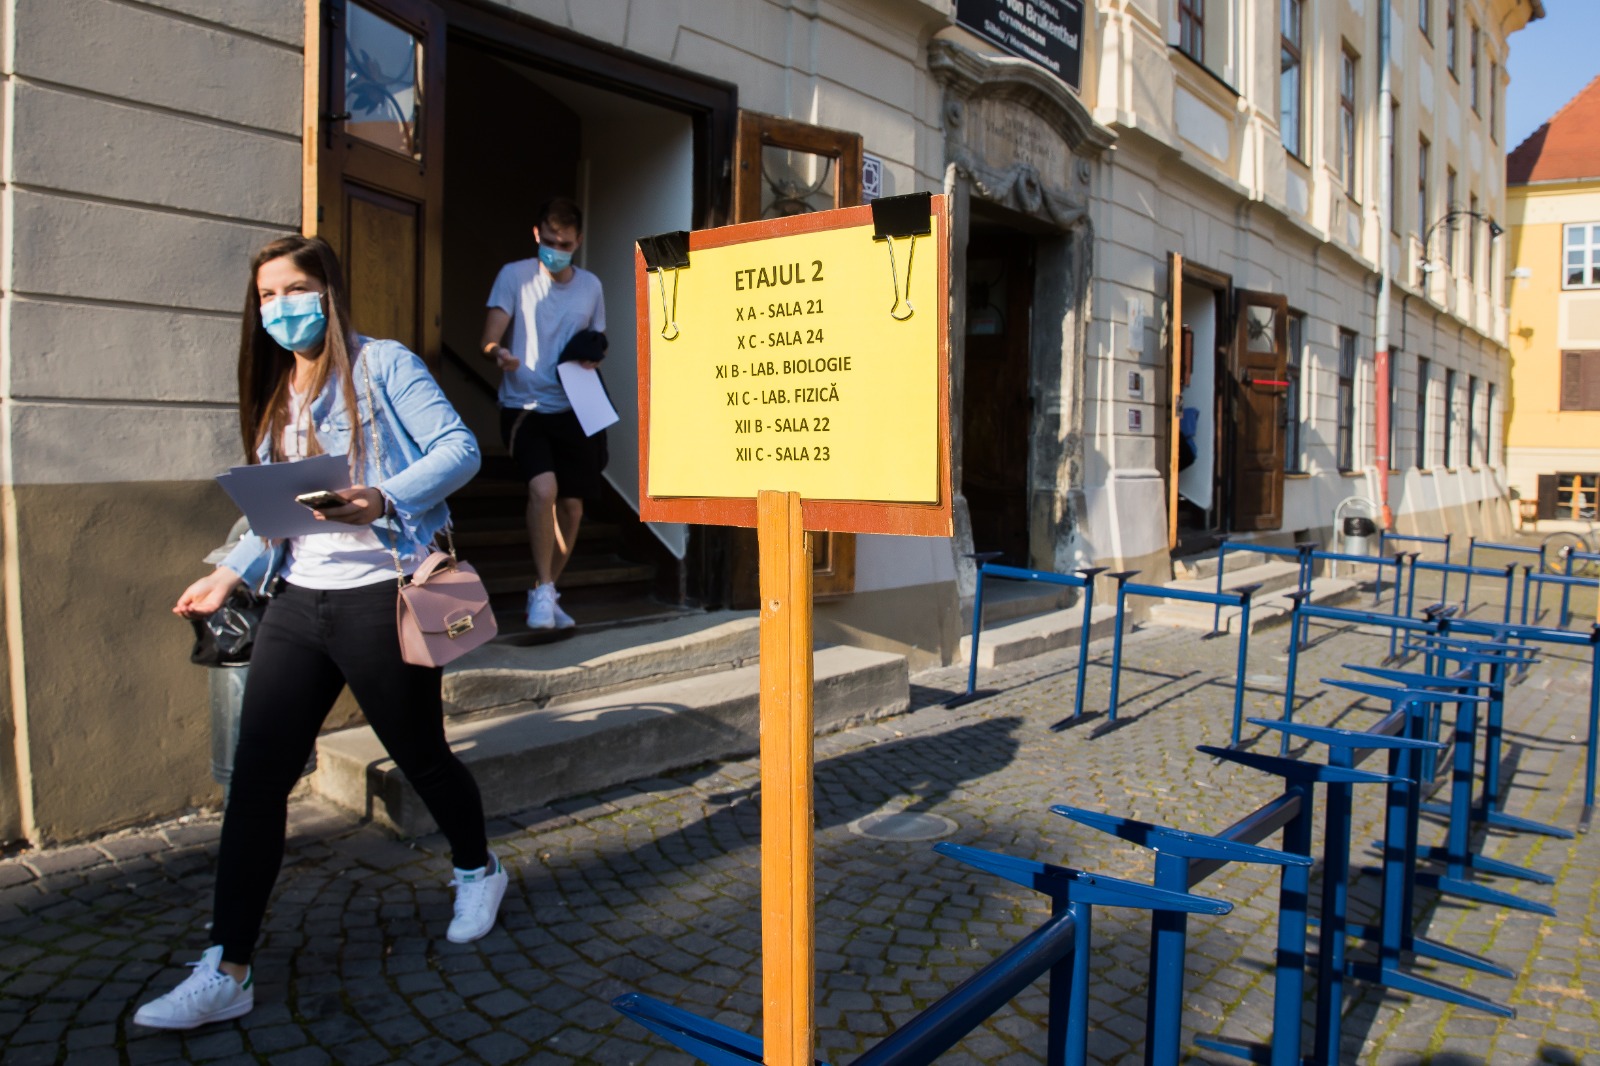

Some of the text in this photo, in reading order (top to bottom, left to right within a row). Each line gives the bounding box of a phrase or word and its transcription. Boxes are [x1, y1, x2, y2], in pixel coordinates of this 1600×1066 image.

[736, 259, 824, 291] ETAJUL 2
[736, 308, 744, 321] X
[748, 306, 756, 320] A
[768, 301, 802, 318] SALA
[806, 299, 824, 314] 21
[738, 335, 745, 349] X
[749, 334, 756, 348] C
[768, 331, 802, 347] SALA
[806, 329, 824, 344] 24
[715, 365, 727, 379] XI
[731, 364, 739, 377] B
[751, 361, 779, 376] LAB.
[783, 356, 852, 374] BIOLOGIE
[727, 392, 738, 406] XI
[742, 392, 750, 405] C
[762, 389, 790, 404] LAB.
[794, 382, 839, 403] FIZICĂ
[735, 419, 750, 434] XII
[755, 419, 762, 432] B
[775, 418, 809, 432] SALA
[813, 417, 830, 432] 22
[736, 448, 751, 461] XII
[756, 448, 763, 461] C
[776, 447, 809, 461] SALA
[814, 446, 830, 461] 23
